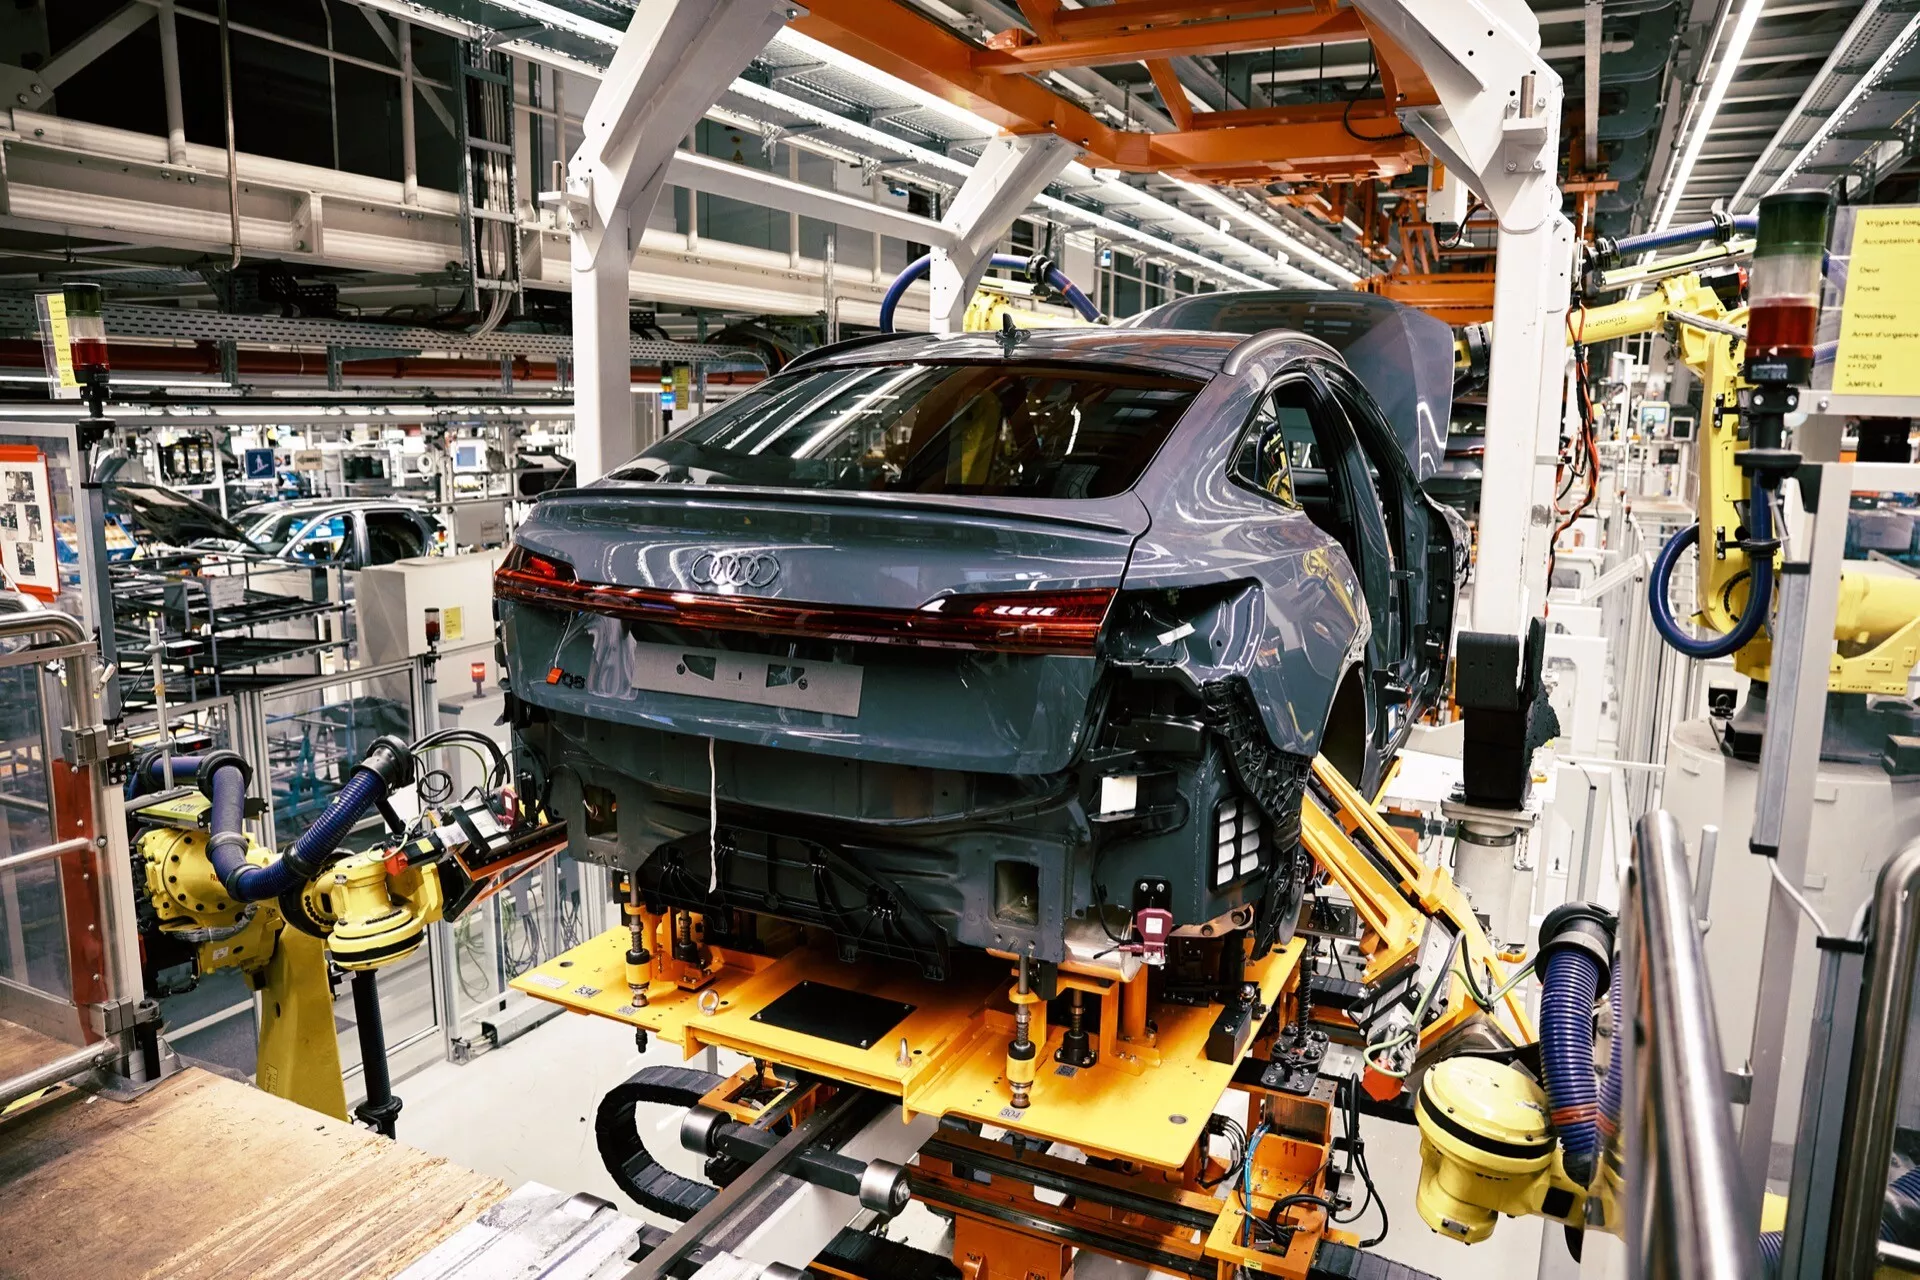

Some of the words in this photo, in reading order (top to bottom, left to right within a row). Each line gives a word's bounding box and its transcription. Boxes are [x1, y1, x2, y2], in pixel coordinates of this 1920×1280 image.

[562, 672, 586, 689] Q8
[1001, 1108, 1021, 1119] 304
[1282, 1140, 1298, 1157] 11
